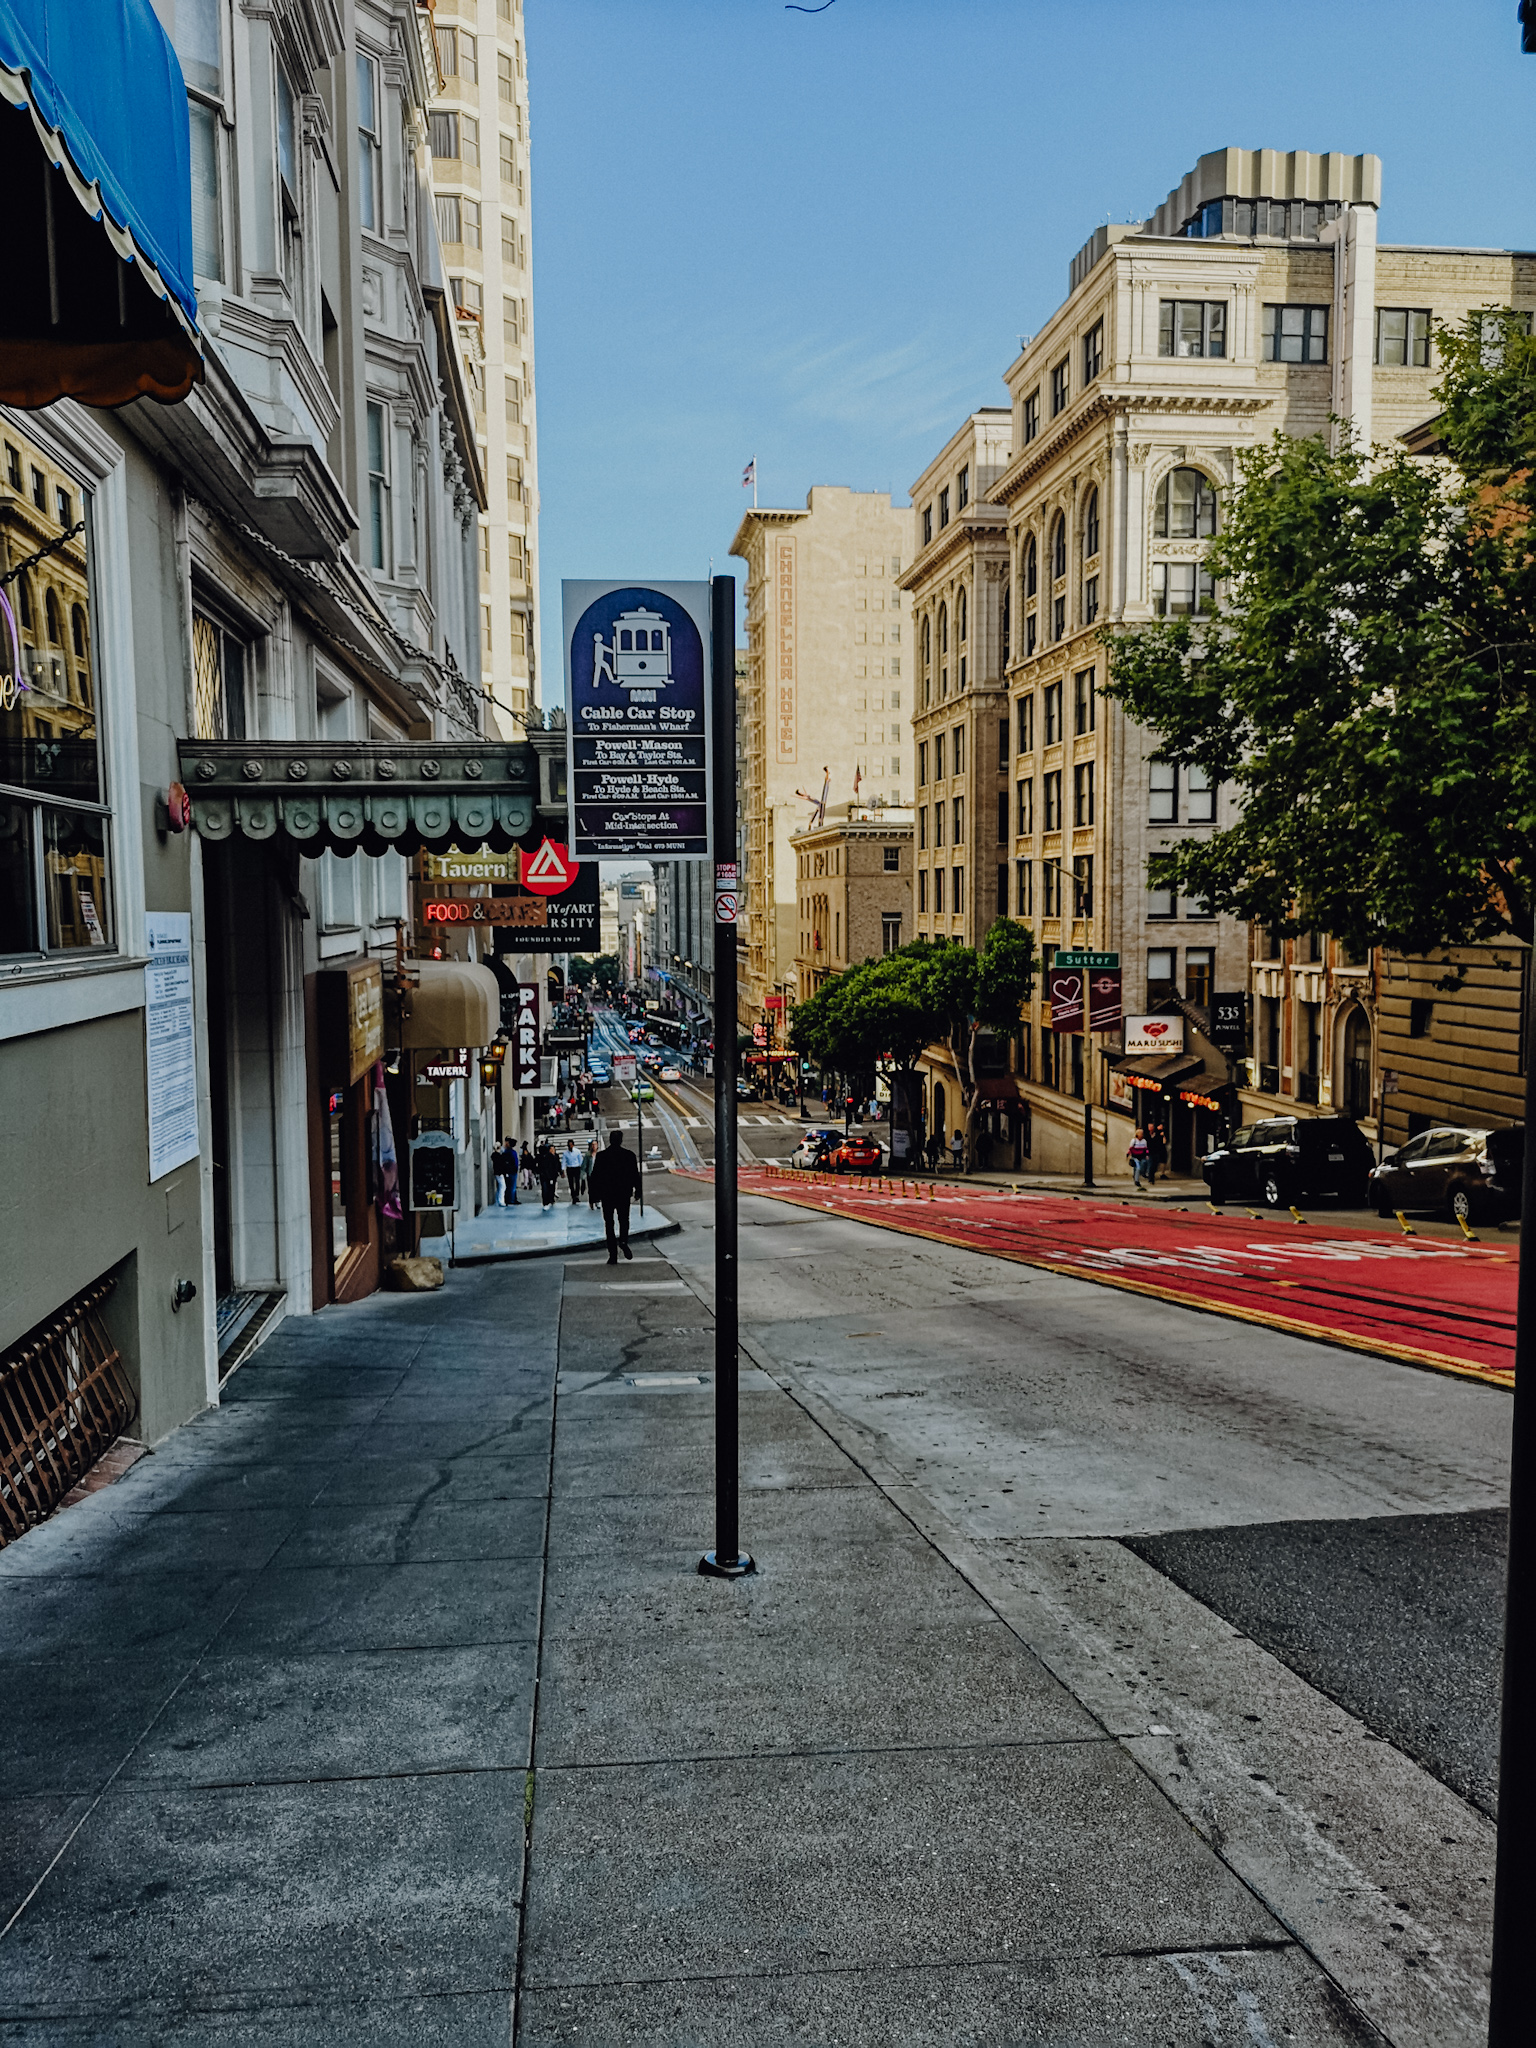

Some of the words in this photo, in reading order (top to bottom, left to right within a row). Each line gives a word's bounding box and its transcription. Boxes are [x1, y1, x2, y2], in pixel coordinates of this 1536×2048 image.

[780, 547, 792, 680] CHANCELLOR
[581, 706, 624, 719] Cable
[627, 706, 655, 719] Car
[659, 706, 696, 722] Stop
[780, 687, 792, 753] HOTEL
[587, 723, 600, 731] To
[602, 723, 656, 731] Fisherman's
[659, 723, 689, 731] Wharf
[595, 740, 683, 750] Powell-Mason
[595, 751, 607, 759] To
[609, 751, 626, 761] Bay
[637, 751, 666, 761] Taylor
[601, 774, 679, 786] Powell-Hyde
[593, 785, 605, 793] To
[607, 785, 631, 795] Hyde
[641, 785, 669, 793] Beach
[658, 812, 670, 820] At
[437, 858, 506, 877] Tavern
[427, 903, 469, 921] FOOD
[472, 903, 485, 920] &
[1066, 955, 1109, 965] Sutter
[1217, 1006, 1239, 1020] 535
[518, 988, 536, 1064] PARK
[427, 1066, 469, 1077] TAVERN
